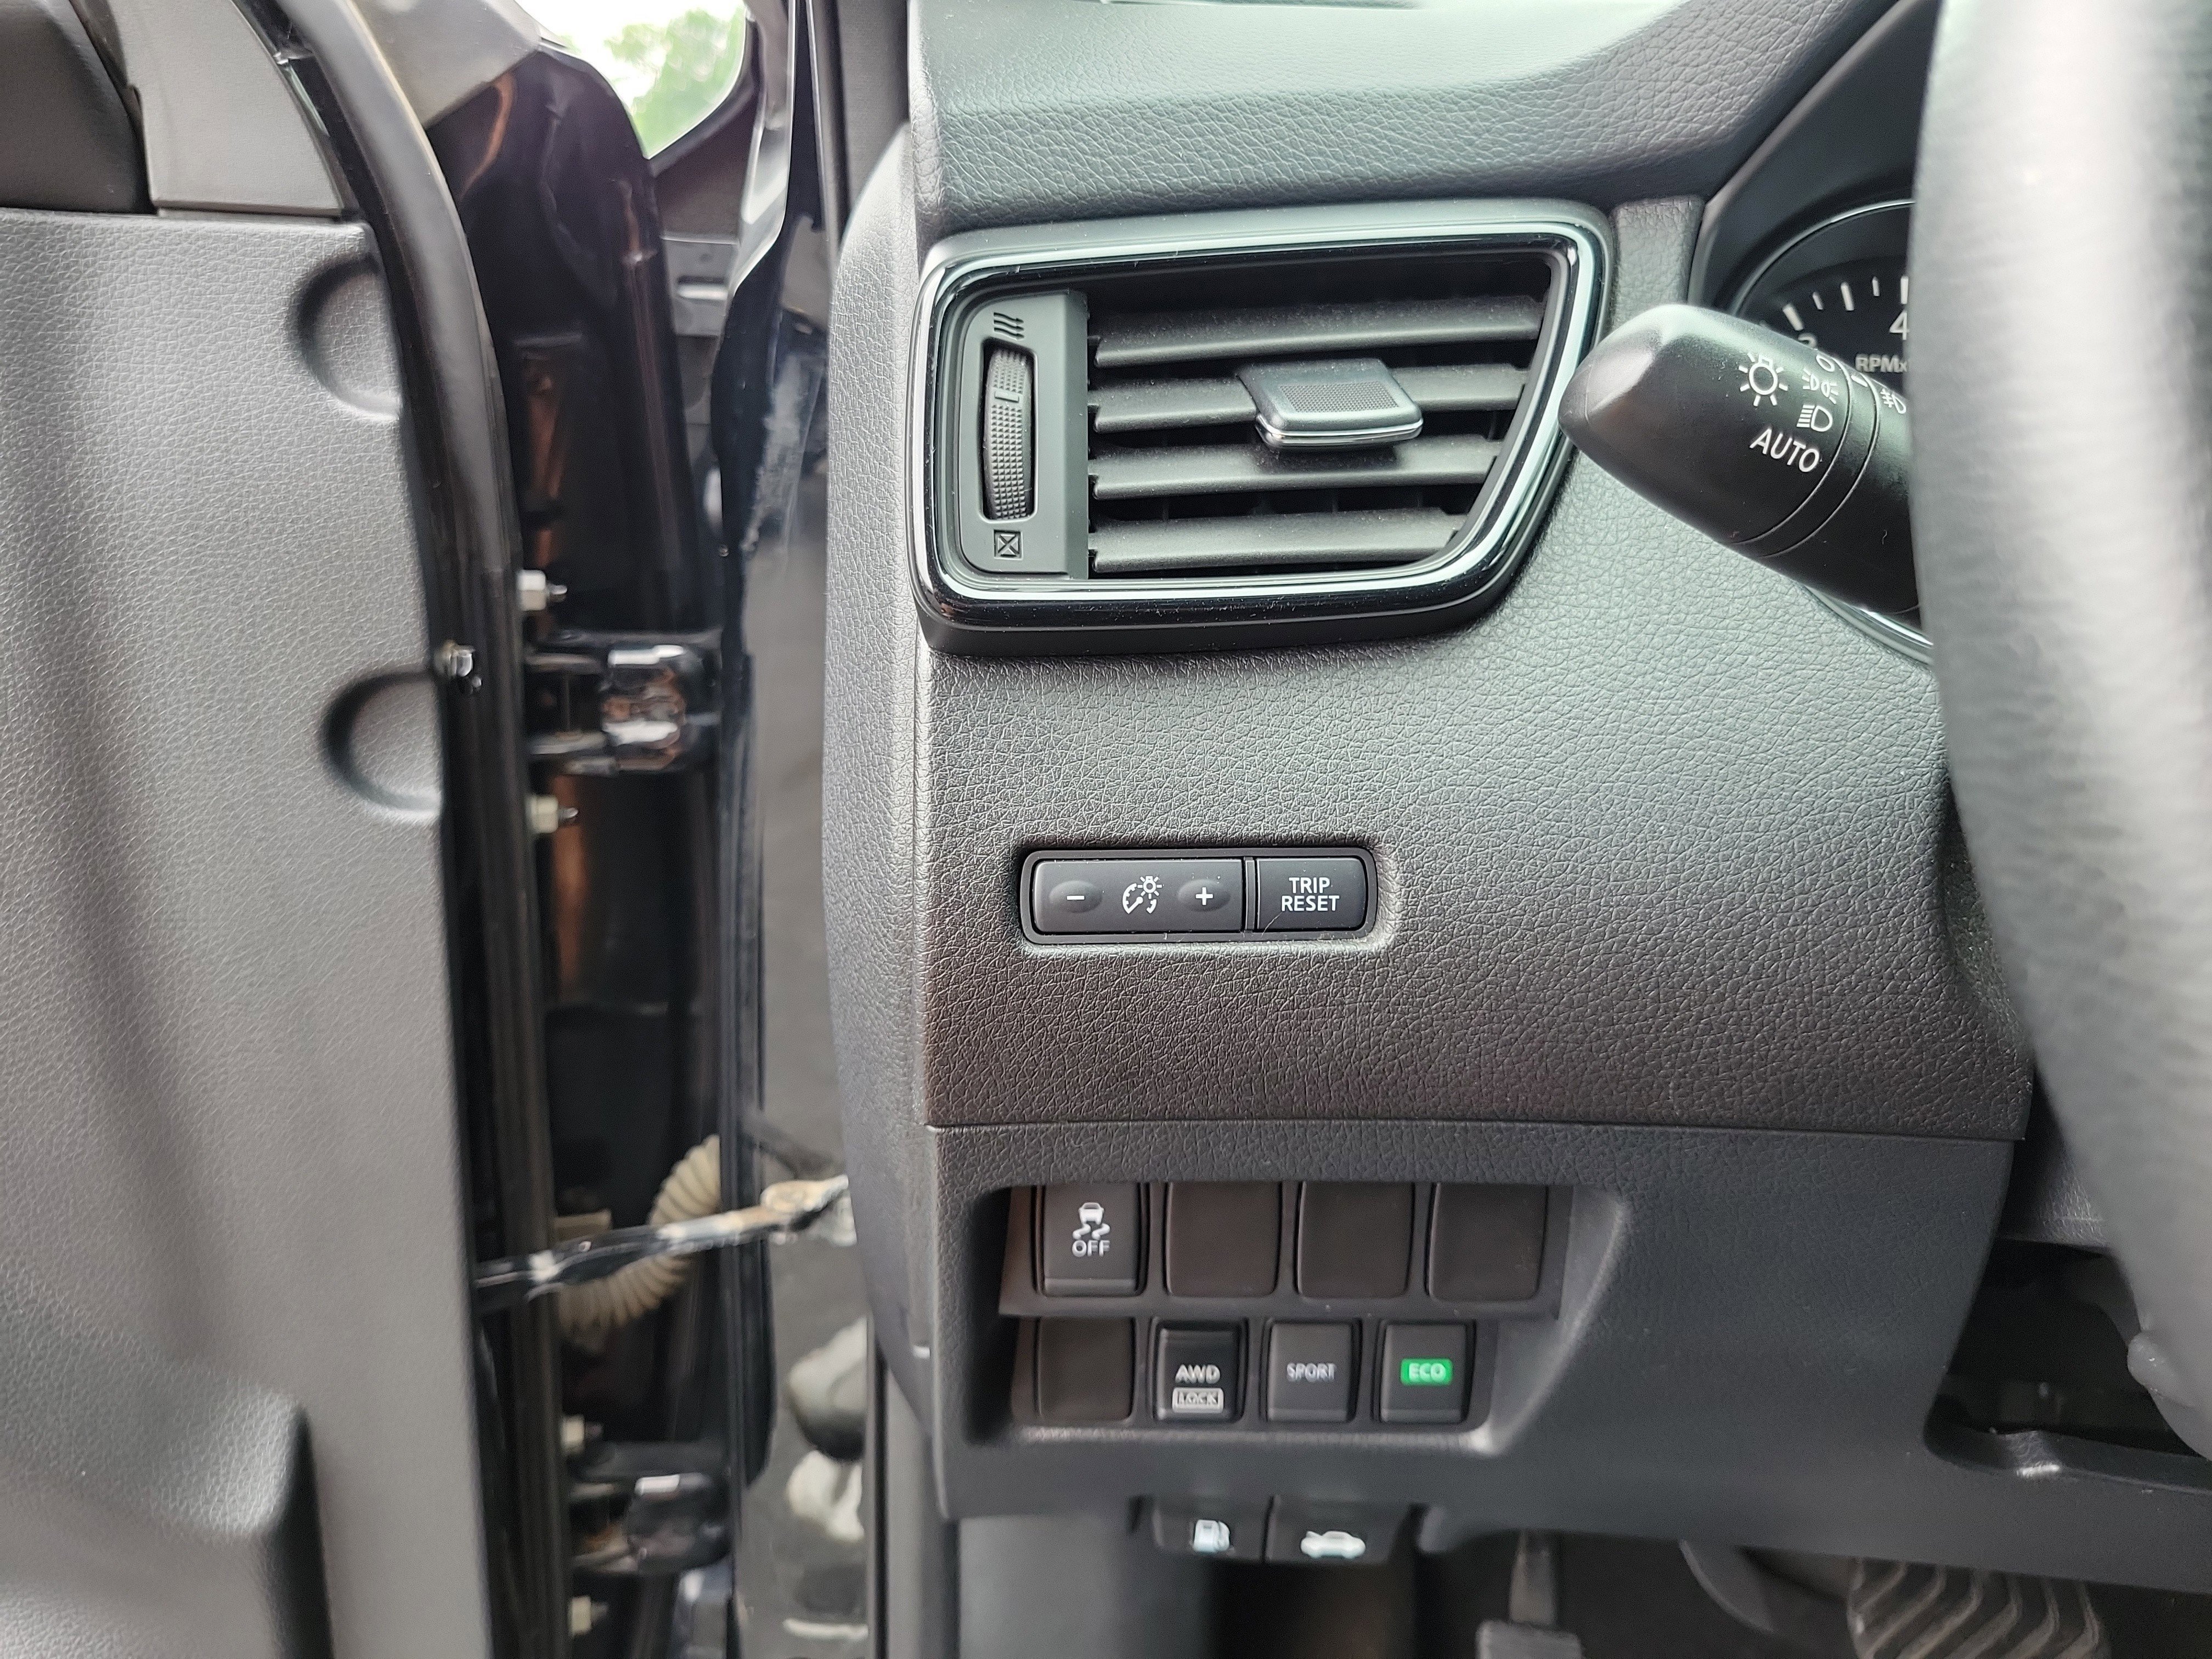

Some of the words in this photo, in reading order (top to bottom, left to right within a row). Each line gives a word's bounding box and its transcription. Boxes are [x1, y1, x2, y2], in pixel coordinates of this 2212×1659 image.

[1750, 427, 1820, 472] AUTO
[1289, 877, 1330, 894] TRIP
[1282, 895, 1340, 911] RESET
[1072, 1240, 1110, 1257] OFF
[1175, 1364, 1221, 1384] AWD
[1287, 1363, 1336, 1383] SPORT
[1408, 1362, 1446, 1383] ECO
